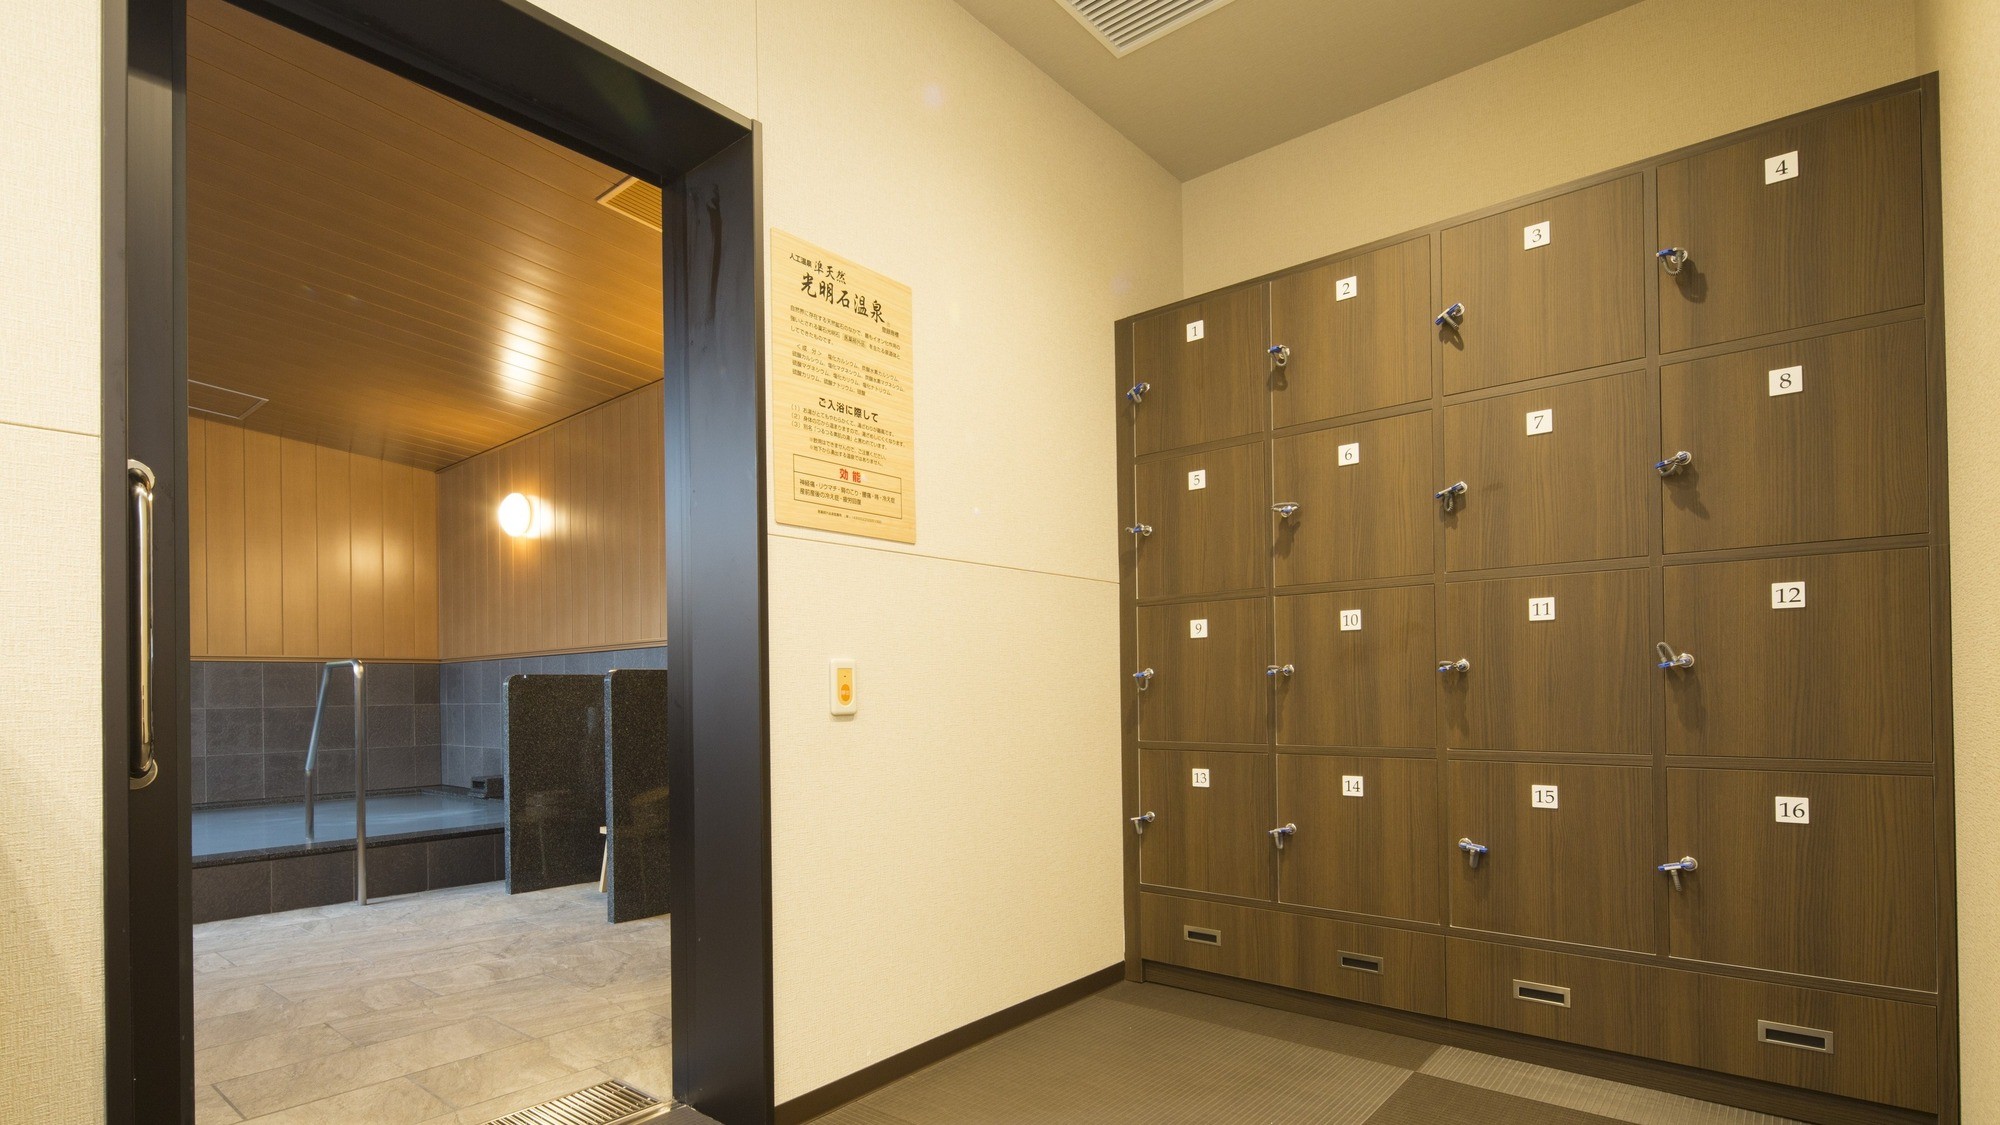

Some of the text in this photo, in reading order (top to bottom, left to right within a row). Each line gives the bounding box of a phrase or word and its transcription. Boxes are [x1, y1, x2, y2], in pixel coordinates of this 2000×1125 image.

[1775, 159, 1789, 176] 4
[1532, 229, 1542, 243] 3
[790, 252, 812, 267] 人工温泉
[1342, 282, 1350, 295] 2
[801, 273, 885, 325] 光明石温泉
[1192, 325, 1198, 337] 1
[1779, 373, 1792, 389] 8
[819, 397, 878, 422] ご入浴に際して
[1534, 415, 1544, 429] 7
[1344, 448, 1352, 460] 6
[1194, 474, 1200, 486] 5
[1775, 587, 1801, 604] 12
[1533, 602, 1551, 616] 11
[1343, 613, 1358, 627] 10
[1195, 623, 1202, 634] 9
[1194, 773, 1207, 784] 13
[1344, 779, 1360, 793] 14
[1534, 789, 1554, 804] 15
[1780, 801, 1805, 819] 16
